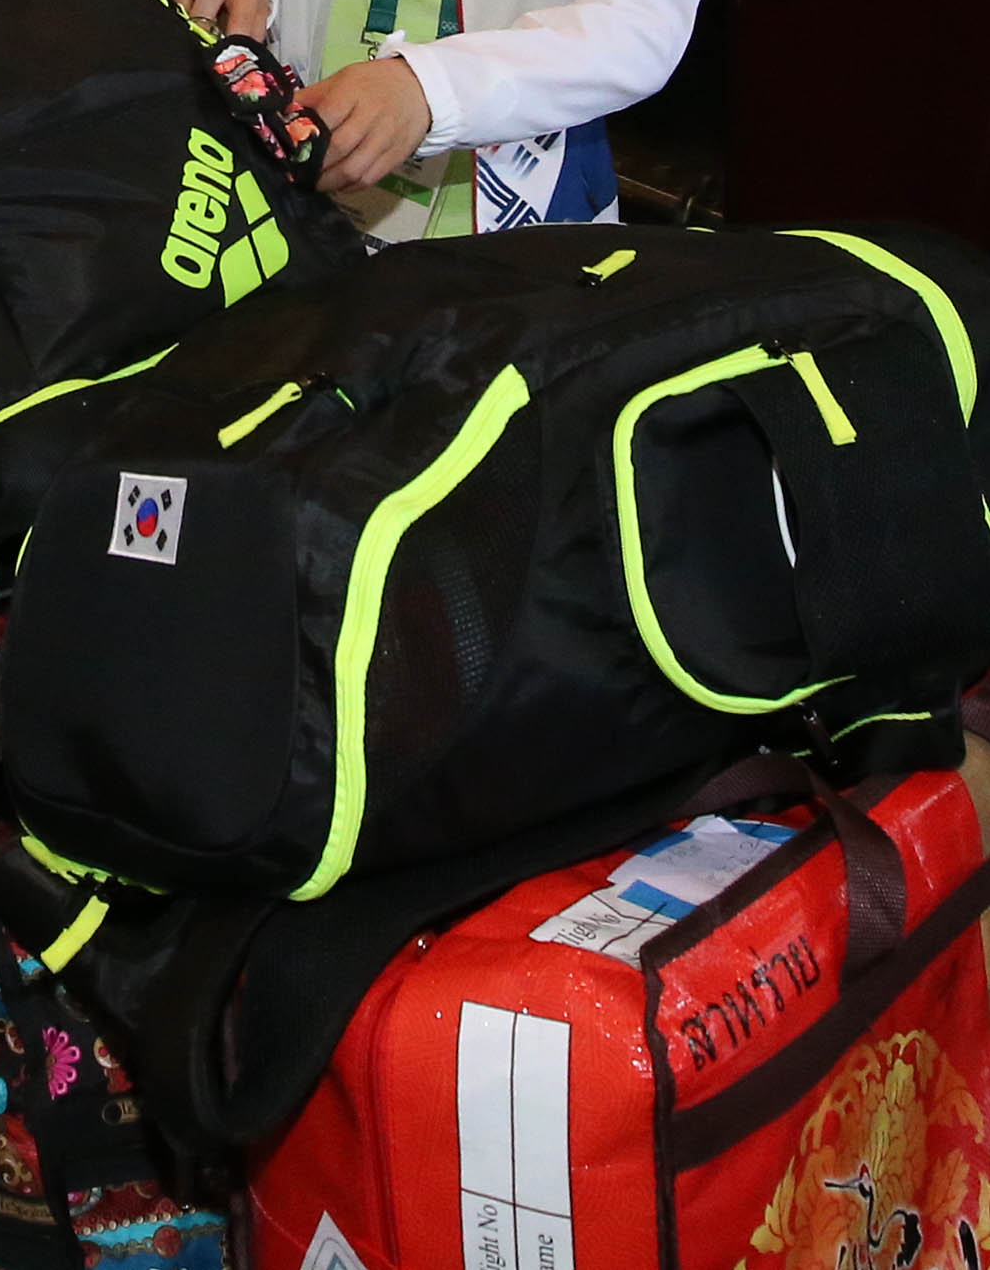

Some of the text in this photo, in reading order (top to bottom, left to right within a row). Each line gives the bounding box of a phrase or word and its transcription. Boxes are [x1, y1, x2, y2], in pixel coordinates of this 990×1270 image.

[160, 126, 235, 290] arena
[681, 934, 821, 1071] สาหร่าย
[476, 1203, 506, 1270] ight No
[538, 1233, 555, 1270] ame
